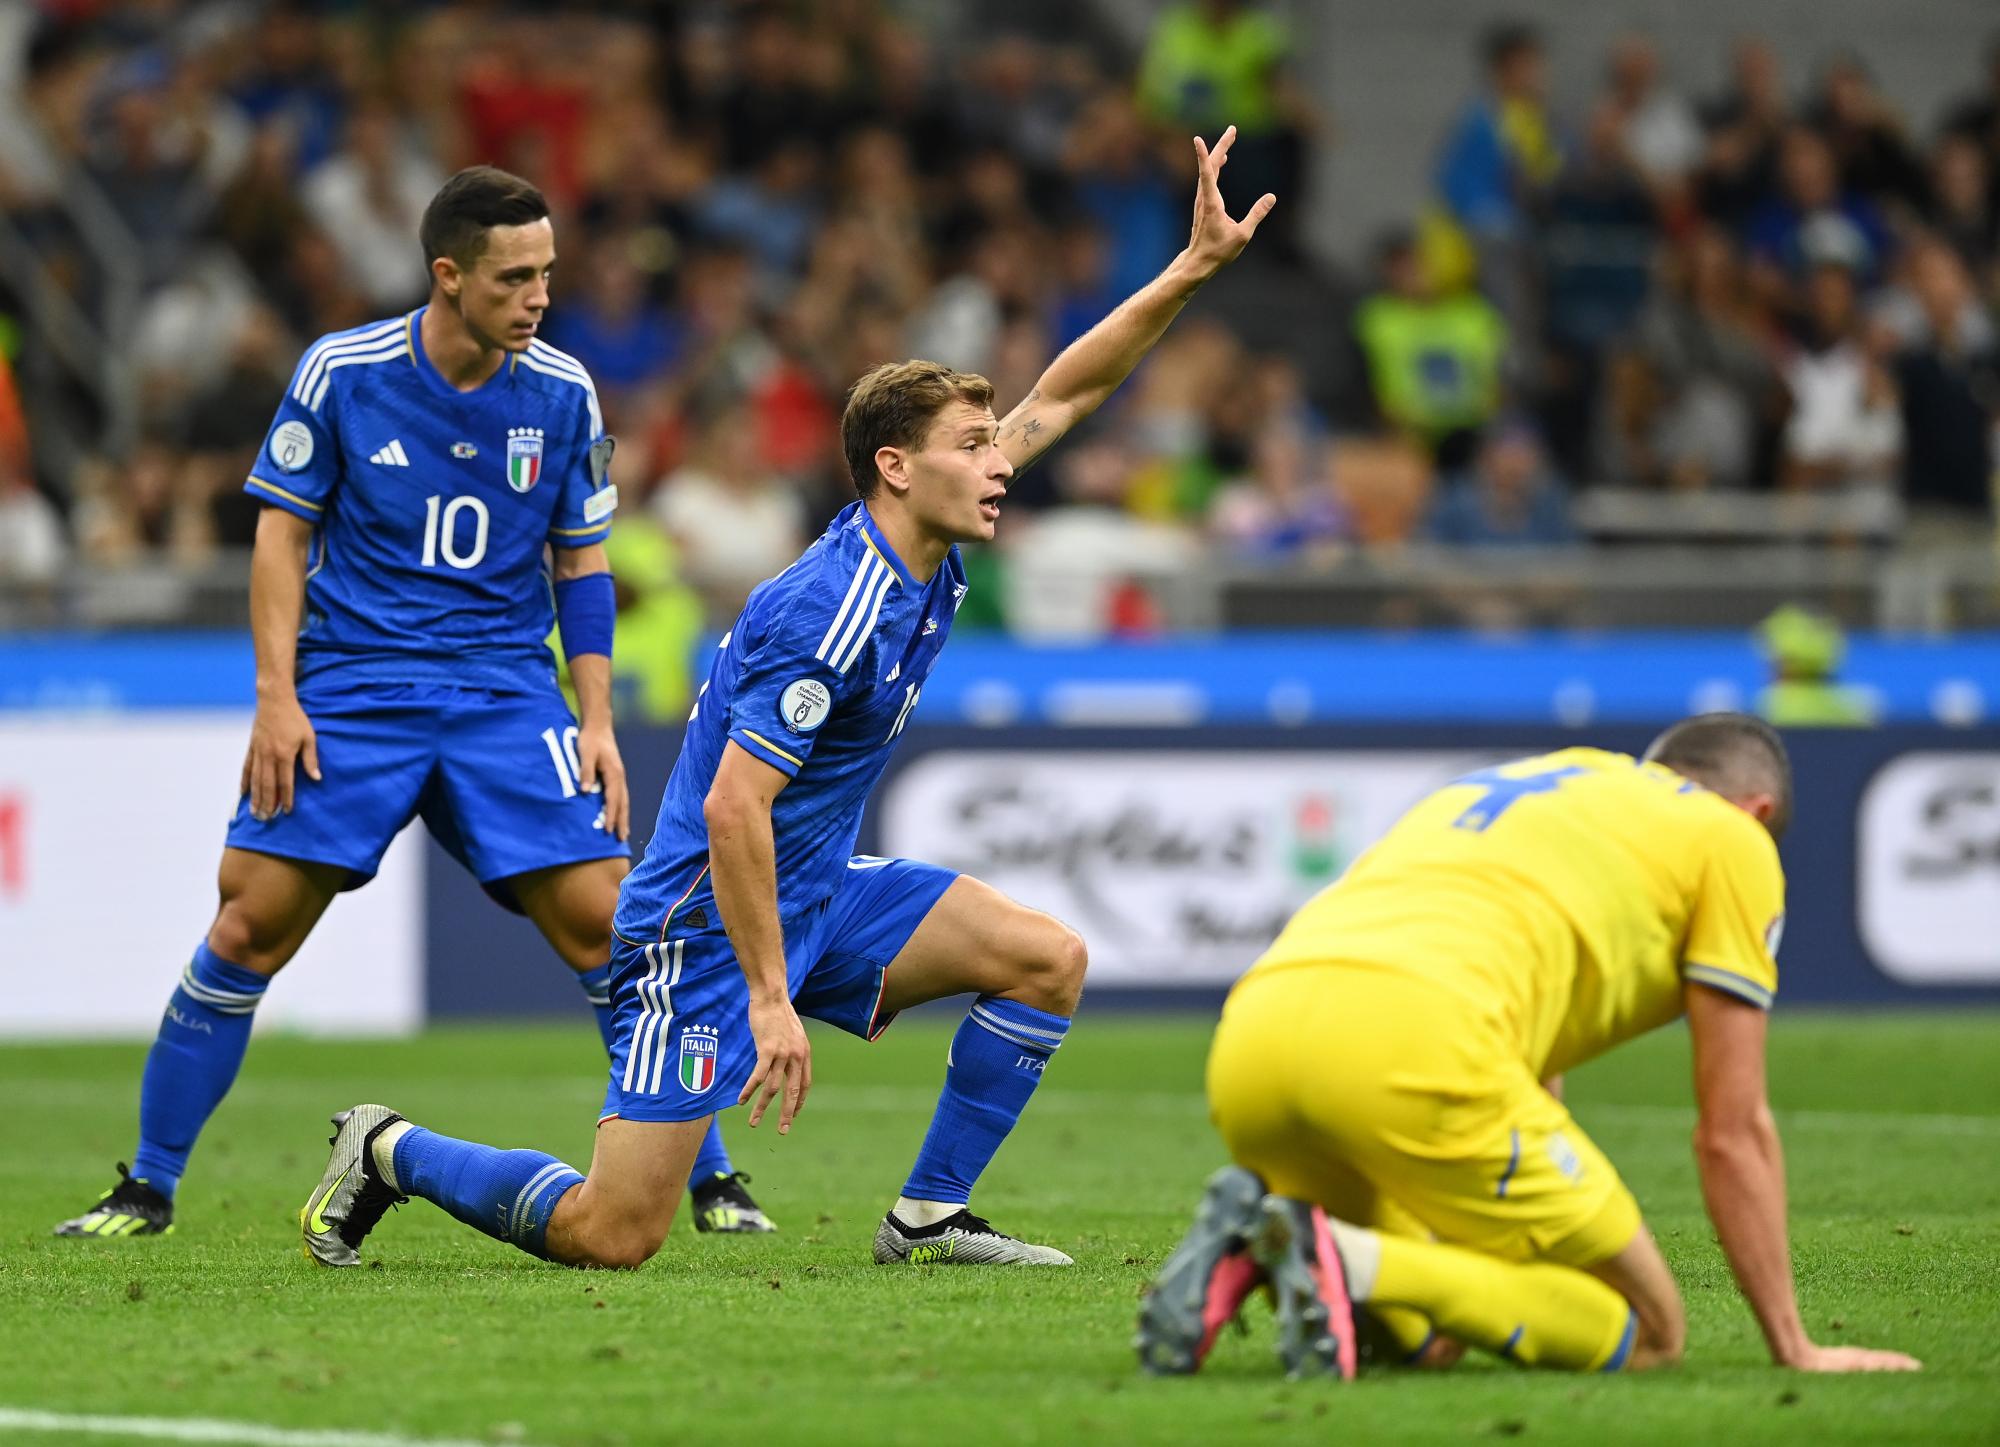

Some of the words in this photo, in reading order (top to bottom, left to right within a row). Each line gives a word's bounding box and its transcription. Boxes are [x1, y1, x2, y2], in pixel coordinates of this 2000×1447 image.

[421, 494, 489, 569] 10
[796, 690, 822, 708] CHAMPIONS
[799, 685, 825, 703] EUROPEAN
[684, 1039, 714, 1053] ITALIA
